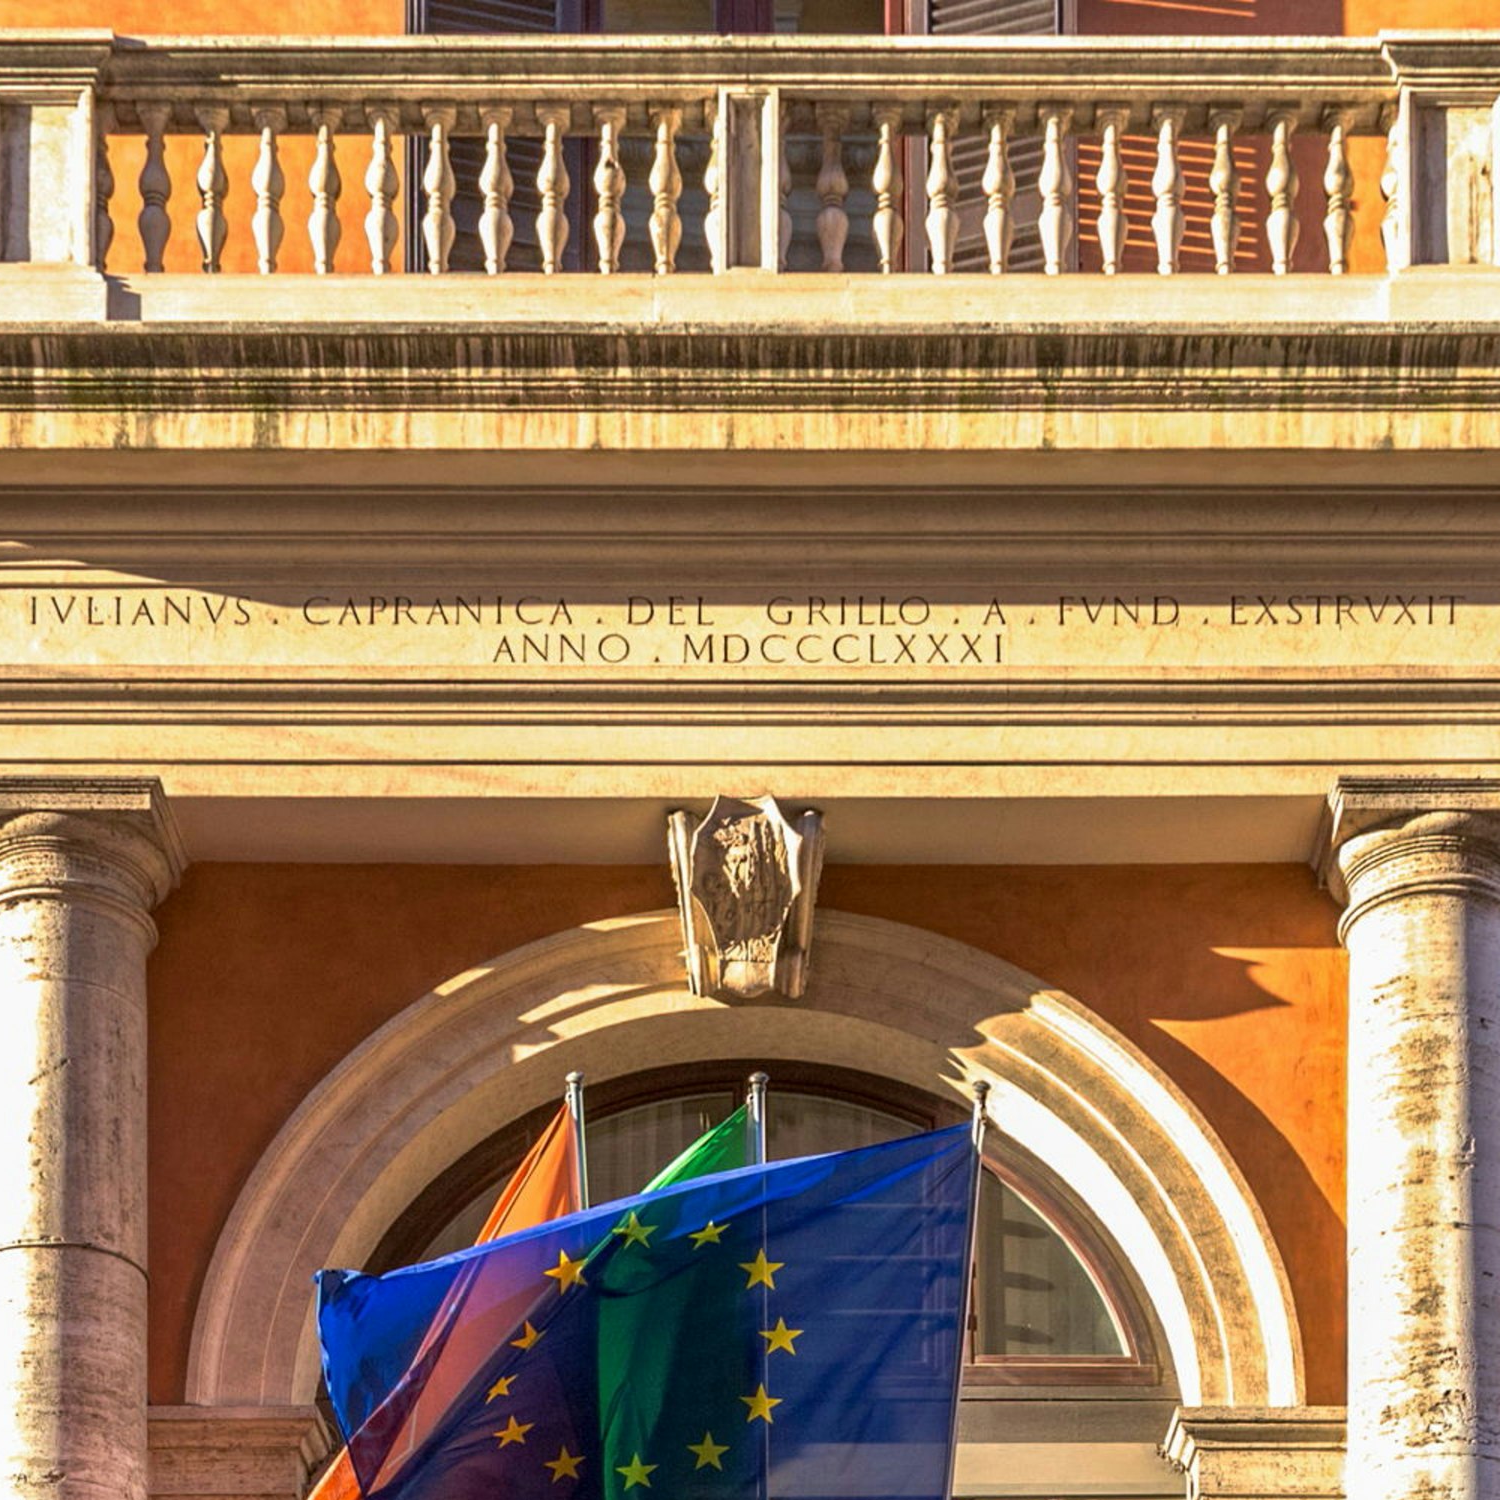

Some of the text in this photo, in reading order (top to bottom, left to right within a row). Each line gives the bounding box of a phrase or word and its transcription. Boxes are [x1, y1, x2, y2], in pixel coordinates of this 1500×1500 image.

[29, 595, 252, 626] IVLIANVS
[302, 595, 573, 626] CAPRANICA
[626, 595, 715, 626] DEL
[765, 595, 931, 626] GRILLO
[983, 595, 1008, 626] A
[1230, 595, 1467, 627] EXSTRVXIT
[492, 633, 1003, 664] ANNO MDCCCLXXXI
